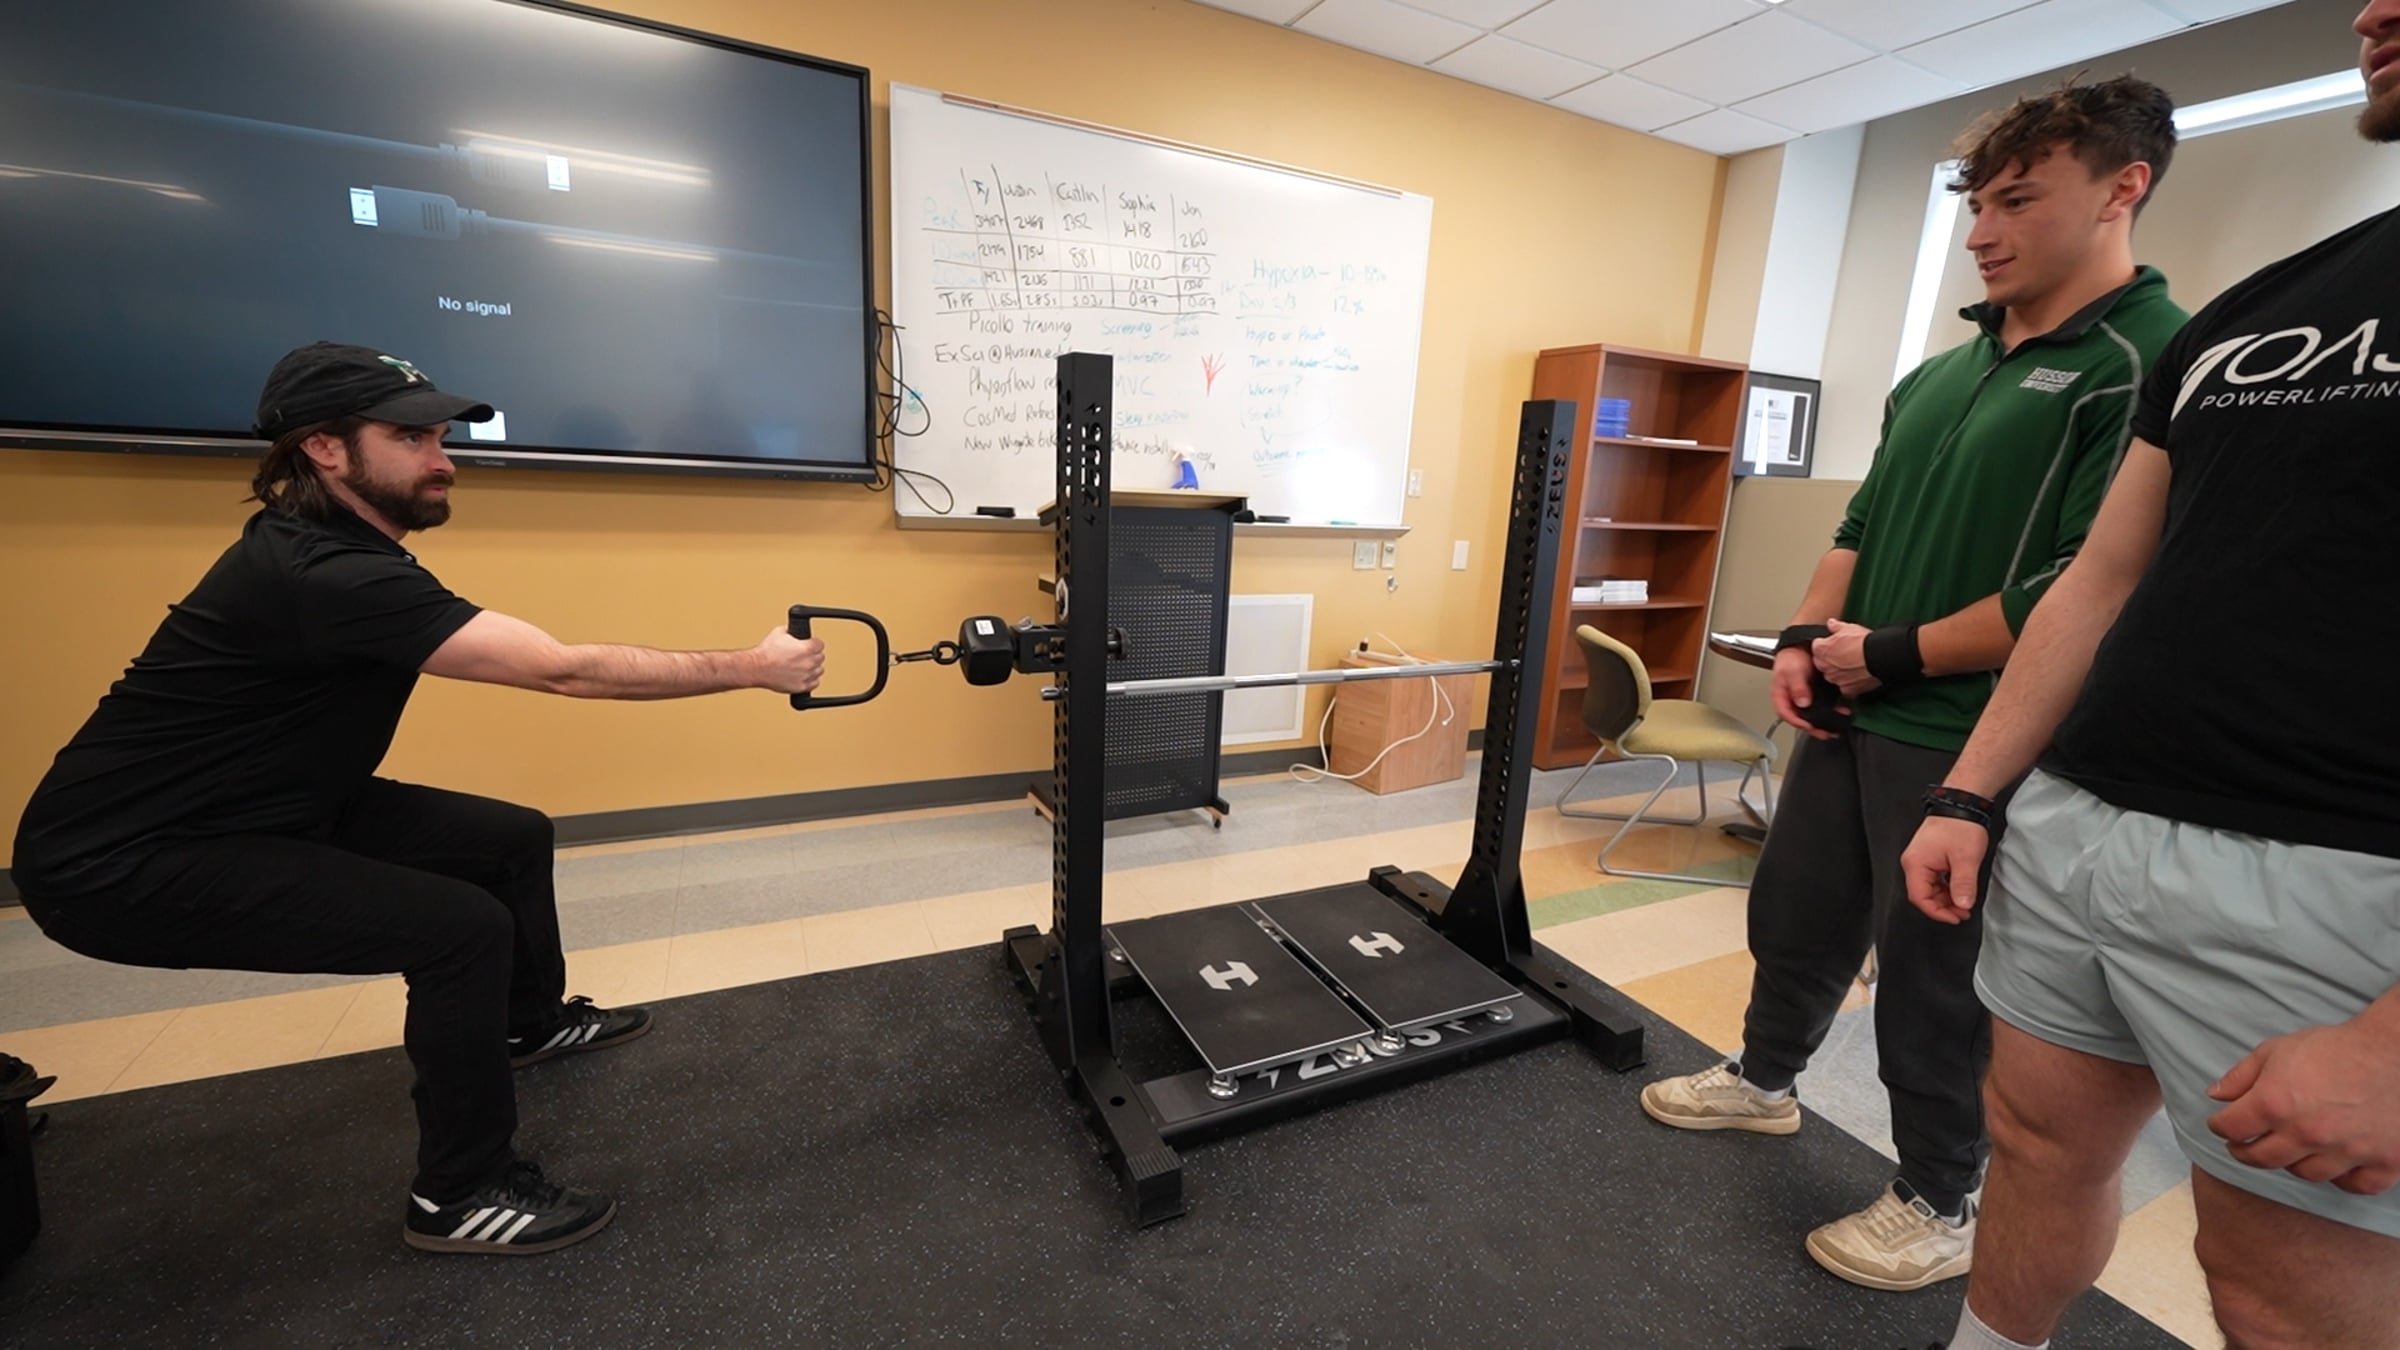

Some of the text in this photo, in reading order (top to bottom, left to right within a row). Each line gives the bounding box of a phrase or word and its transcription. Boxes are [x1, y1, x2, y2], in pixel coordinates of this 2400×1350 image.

[1128, 249, 1162, 272] 1020
[438, 296, 511, 316] No signal
[2198, 380, 2400, 411] POWERLIFTIN
